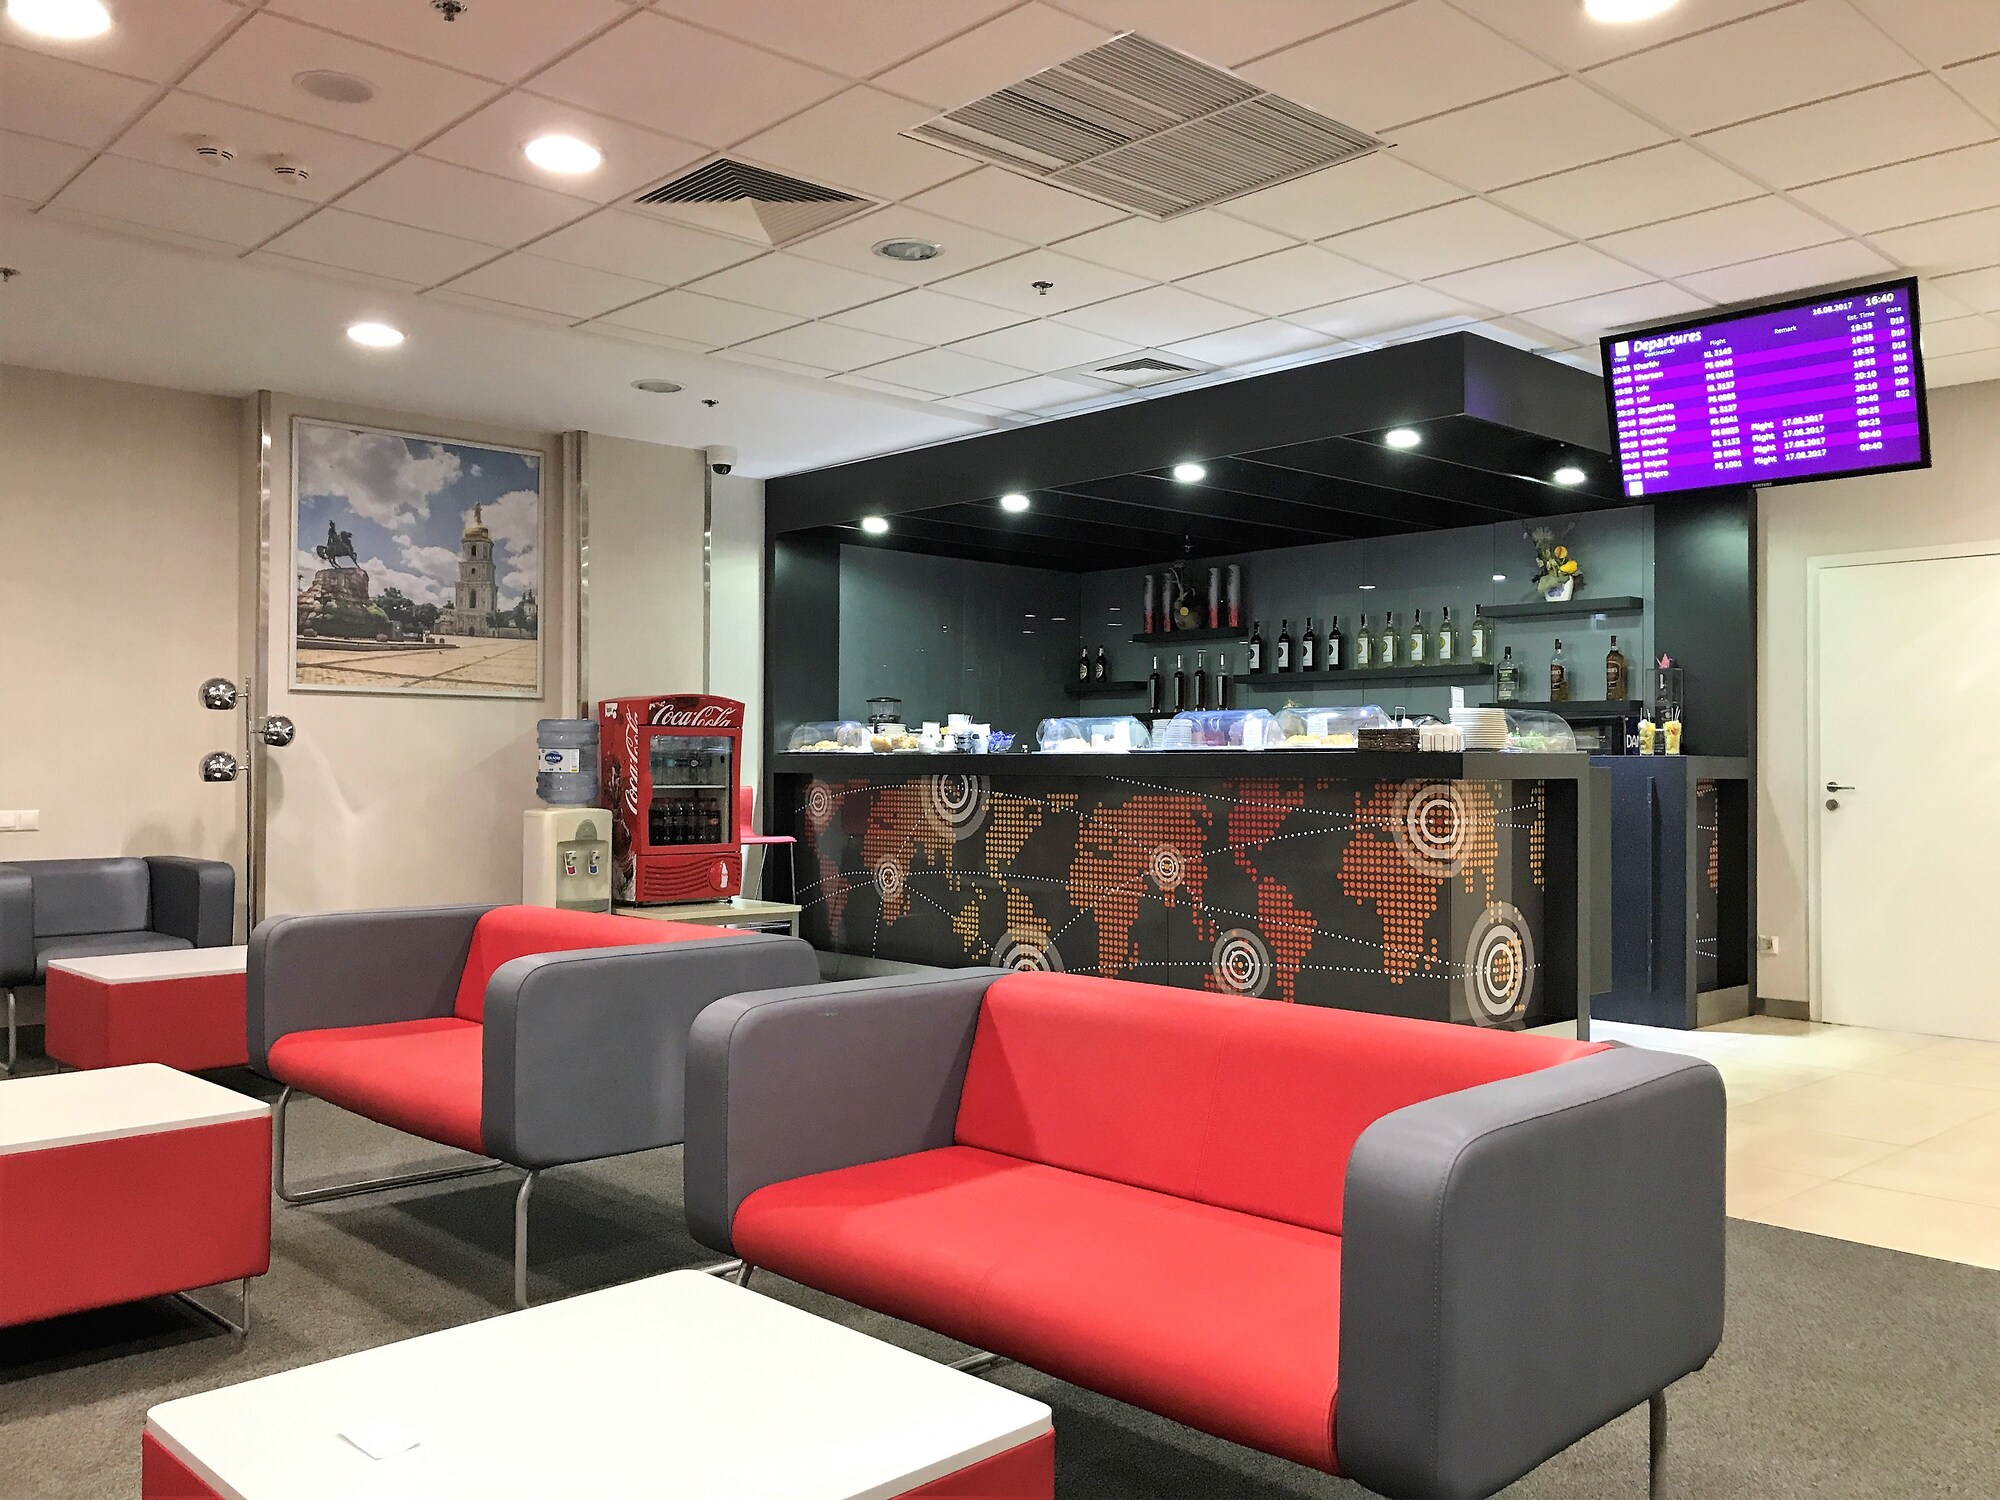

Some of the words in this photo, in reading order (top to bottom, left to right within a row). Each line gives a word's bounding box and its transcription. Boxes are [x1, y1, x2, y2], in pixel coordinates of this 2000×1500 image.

[1866, 293, 1894, 306] 16:40
[1813, 302, 1852, 315] 16.08.2017
[1774, 325, 1797, 334] Remark
[1634, 331, 1701, 353] Departures
[1852, 334, 1874, 344] 19:55
[1644, 348, 1675, 358] Destination
[1714, 347, 1732, 357] 3145
[1853, 346, 1875, 356] 19:55
[1633, 361, 1660, 371] Kharkiv
[1854, 358, 1876, 368] 19:55
[1894, 365, 1908, 374] D20
[1706, 373, 1716, 381] PS
[1854, 370, 1877, 380] 20:10
[1895, 377, 1909, 386] D20
[1636, 385, 1649, 393] Lviv
[1855, 382, 1878, 392] 20:10
[1896, 389, 1910, 398] D22
[1637, 395, 1650, 403] Lviv
[1856, 394, 1879, 404] 20:40
[1782, 414, 1823, 426] 17.08.2017
[1751, 422, 1774, 432] Flight
[1783, 425, 1825, 438] 17.08.2017
[1711, 429, 1721, 437] PS
[1752, 433, 1775, 442] Flight
[1712, 440, 1722, 448] KL
[1784, 437, 1825, 449] 17.08.2017
[1642, 448, 1668, 457] Kharkiv
[1753, 444, 1776, 454] Flight
[1785, 449, 1826, 461] 17.08.2017
[1643, 460, 1668, 468] Dnipro
[1725, 460, 1742, 469] 1001
[1754, 456, 1777, 465] Flight
[1644, 471, 1669, 479] Dnipro
[651, 704, 737, 727] Coca-Cola
[625, 704, 639, 815] Coca-Cola
